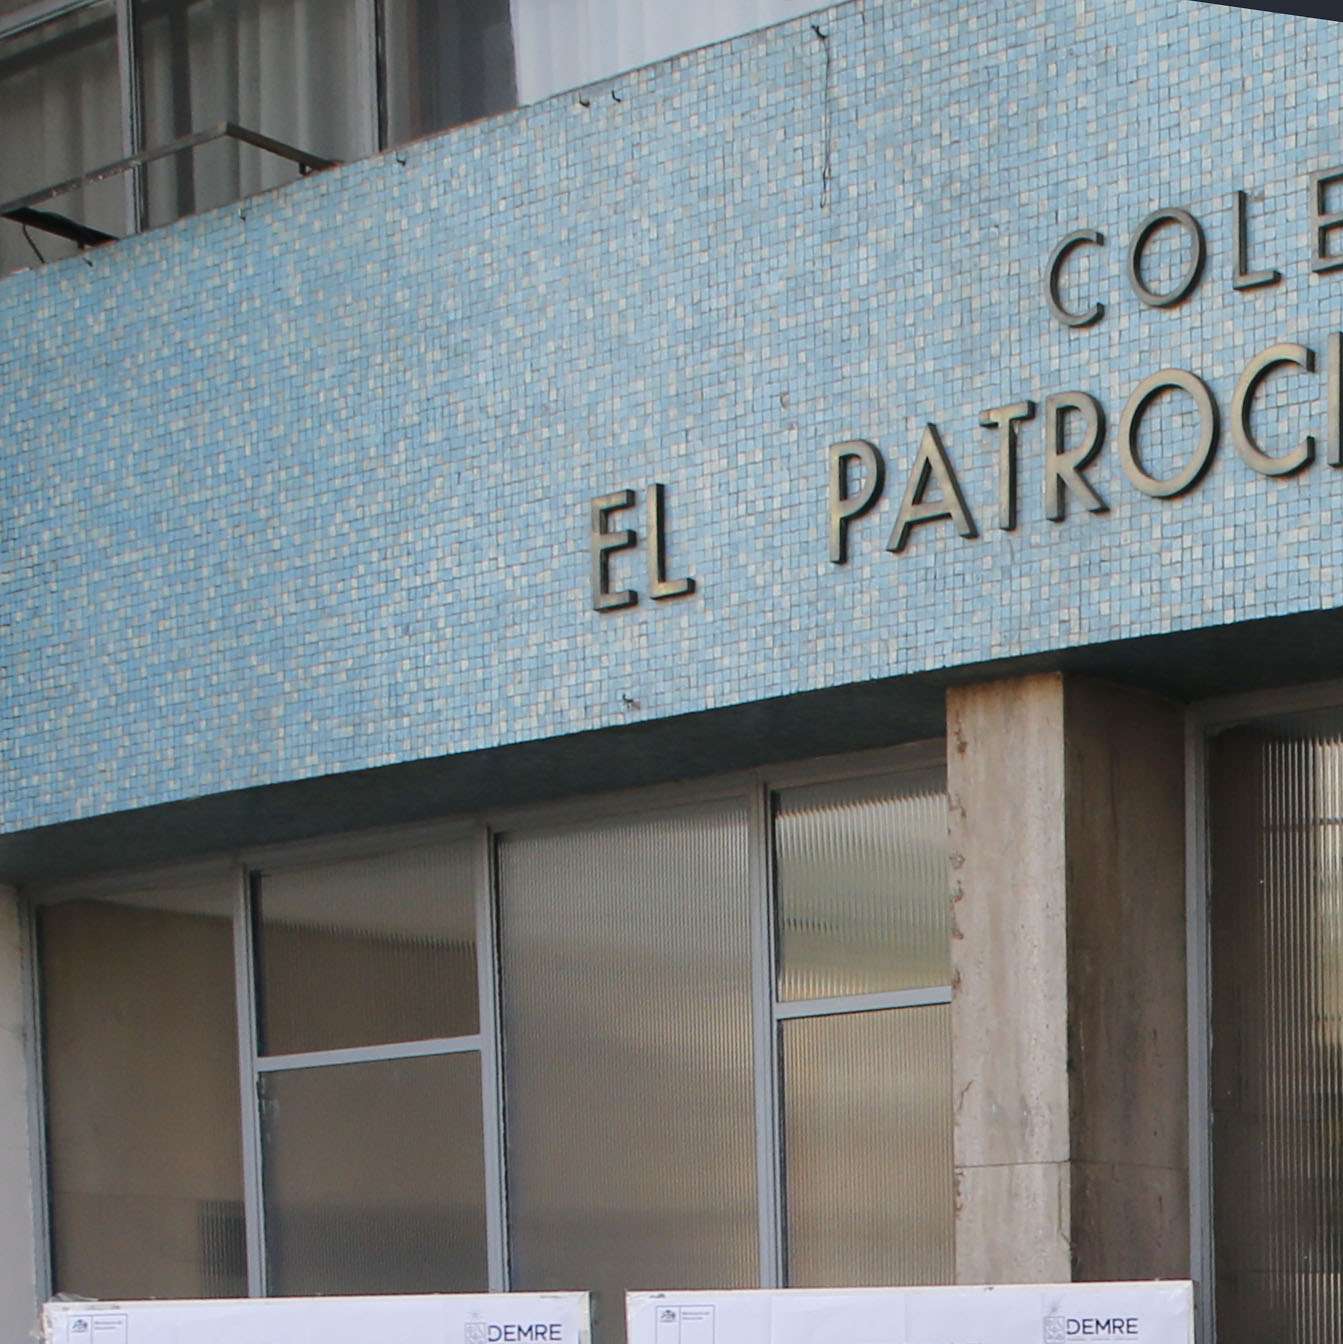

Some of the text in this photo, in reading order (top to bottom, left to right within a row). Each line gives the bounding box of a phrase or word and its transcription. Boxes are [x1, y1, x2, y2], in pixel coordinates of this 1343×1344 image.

[589, 482, 696, 614] EL
[487, 1323, 562, 1342] DEMRE
[1066, 1317, 1139, 1335] DEMRE
